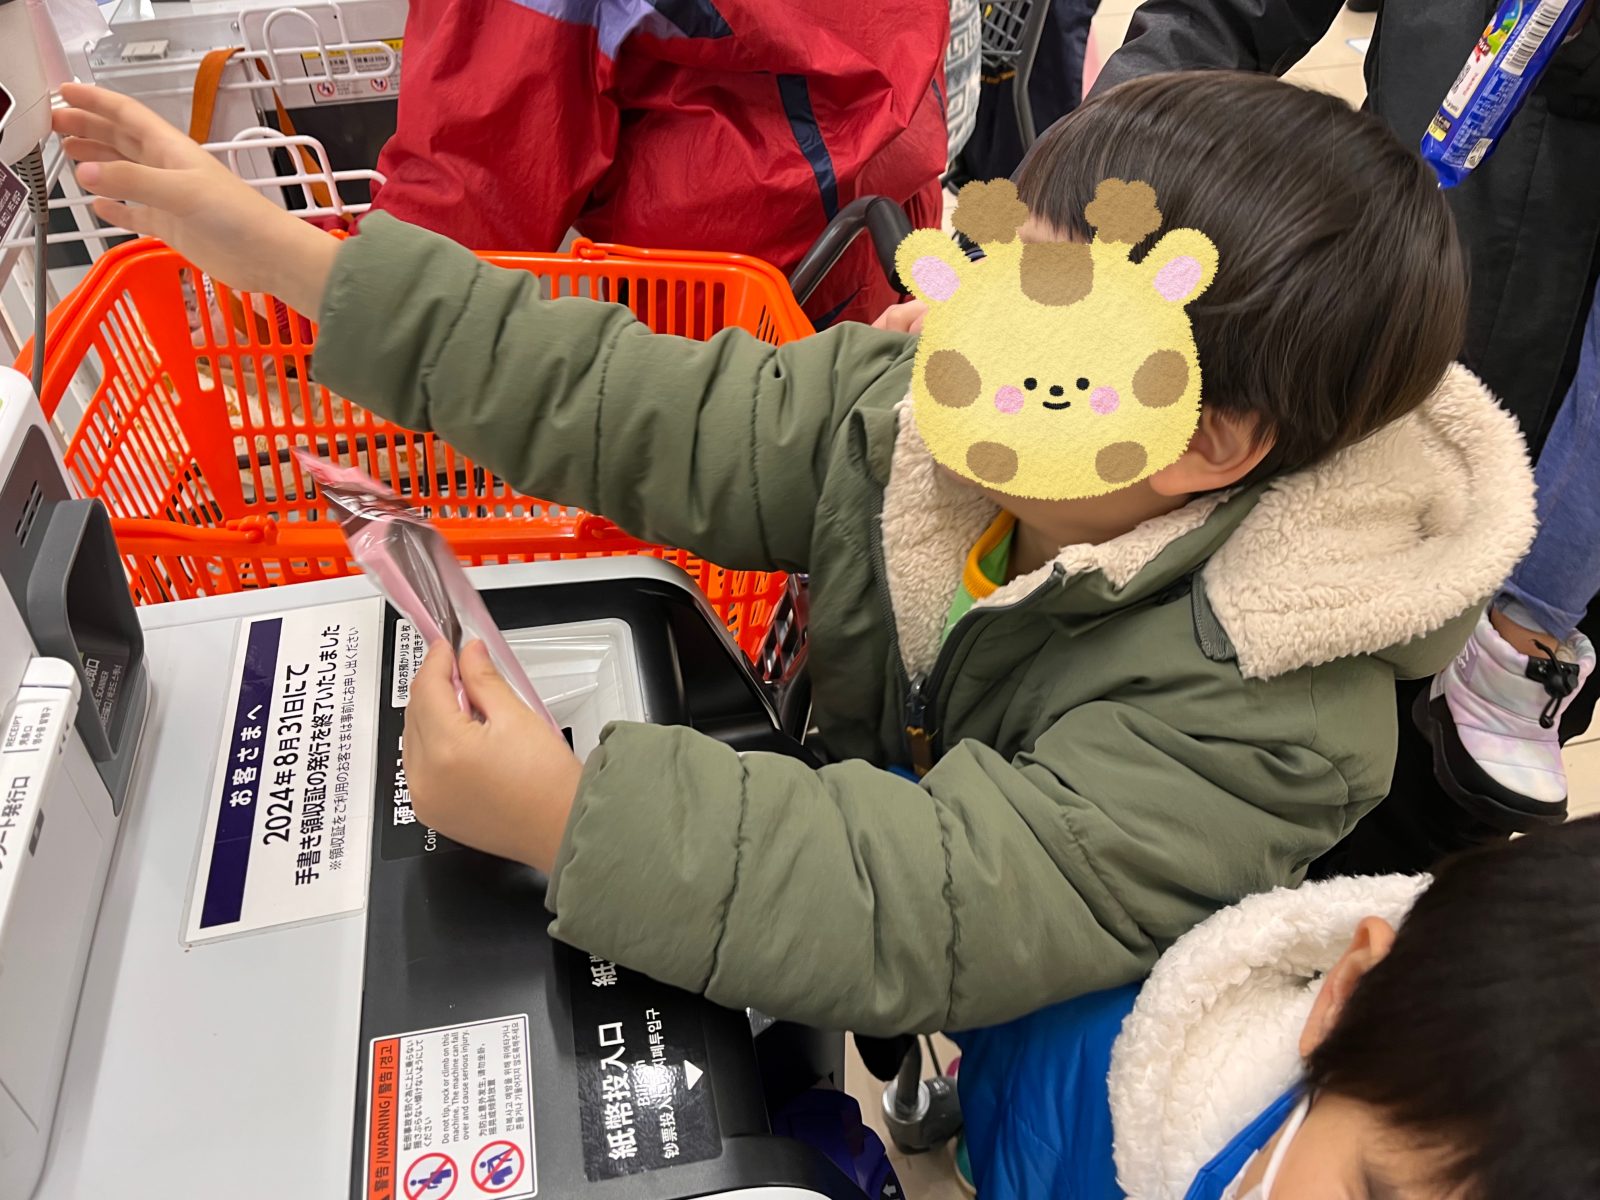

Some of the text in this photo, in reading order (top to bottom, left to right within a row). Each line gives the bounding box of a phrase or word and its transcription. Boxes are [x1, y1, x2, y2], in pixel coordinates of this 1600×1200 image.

[5, 716, 23, 747] RECEIPT
[229, 704, 263, 808] お客さまへ
[263, 663, 310, 845] 2024年8月31日にて
[295, 624, 340, 886] 手書き領収証の発行を終了いたしました
[441, 1033, 449, 1046] this
[451, 1032, 459, 1043] fall
[442, 1048, 449, 1056] on
[441, 1058, 449, 1077] climb
[451, 1058, 459, 1089] machine
[460, 1054, 469, 1081] serious
[442, 1079, 449, 1087] or
[598, 1021, 638, 1161] 紙幣投入口
[451, 1091, 459, 1105] The
[461, 1106, 469, 1121] and
[442, 1134, 450, 1144] Do
[462, 1123, 470, 1140] over
